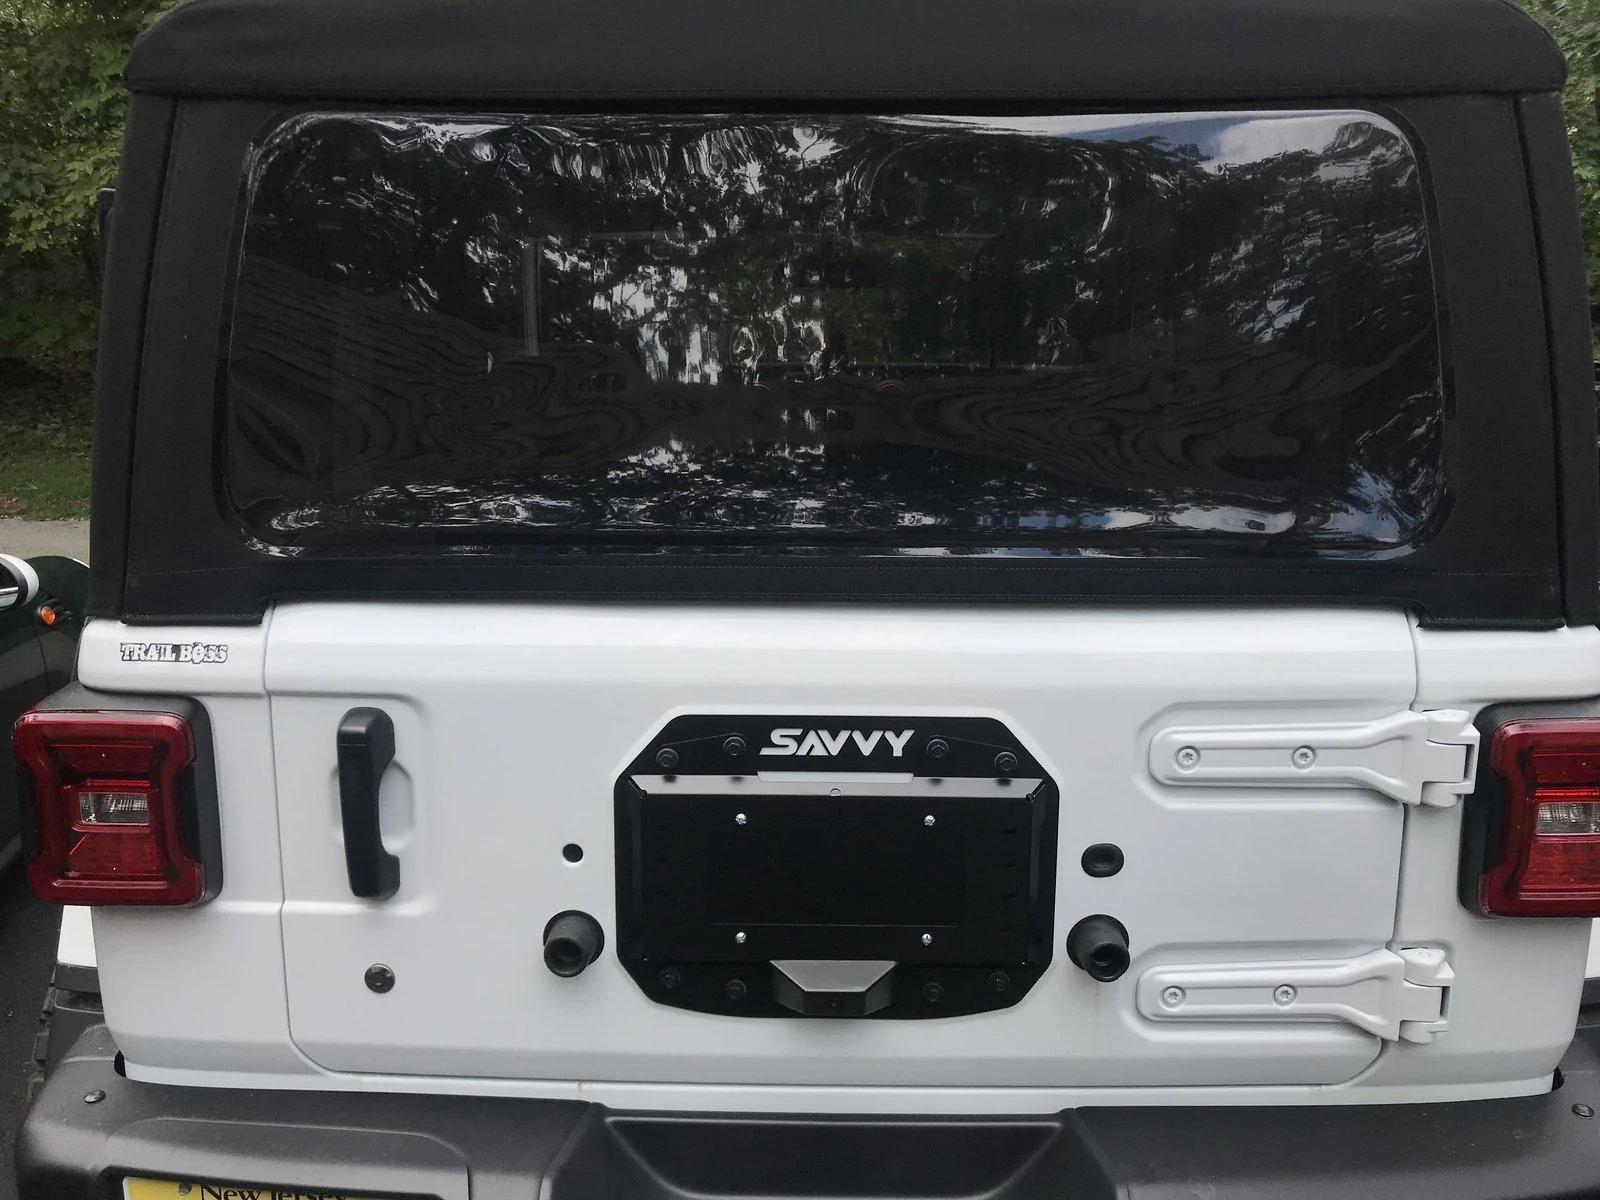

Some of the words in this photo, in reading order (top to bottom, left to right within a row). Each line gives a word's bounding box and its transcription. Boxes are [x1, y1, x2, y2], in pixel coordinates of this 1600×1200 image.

[120, 643, 176, 662] TRAIL
[179, 642, 228, 664] BOSS
[759, 728, 915, 757] SAVVY
[201, 1185, 263, 1200] New
